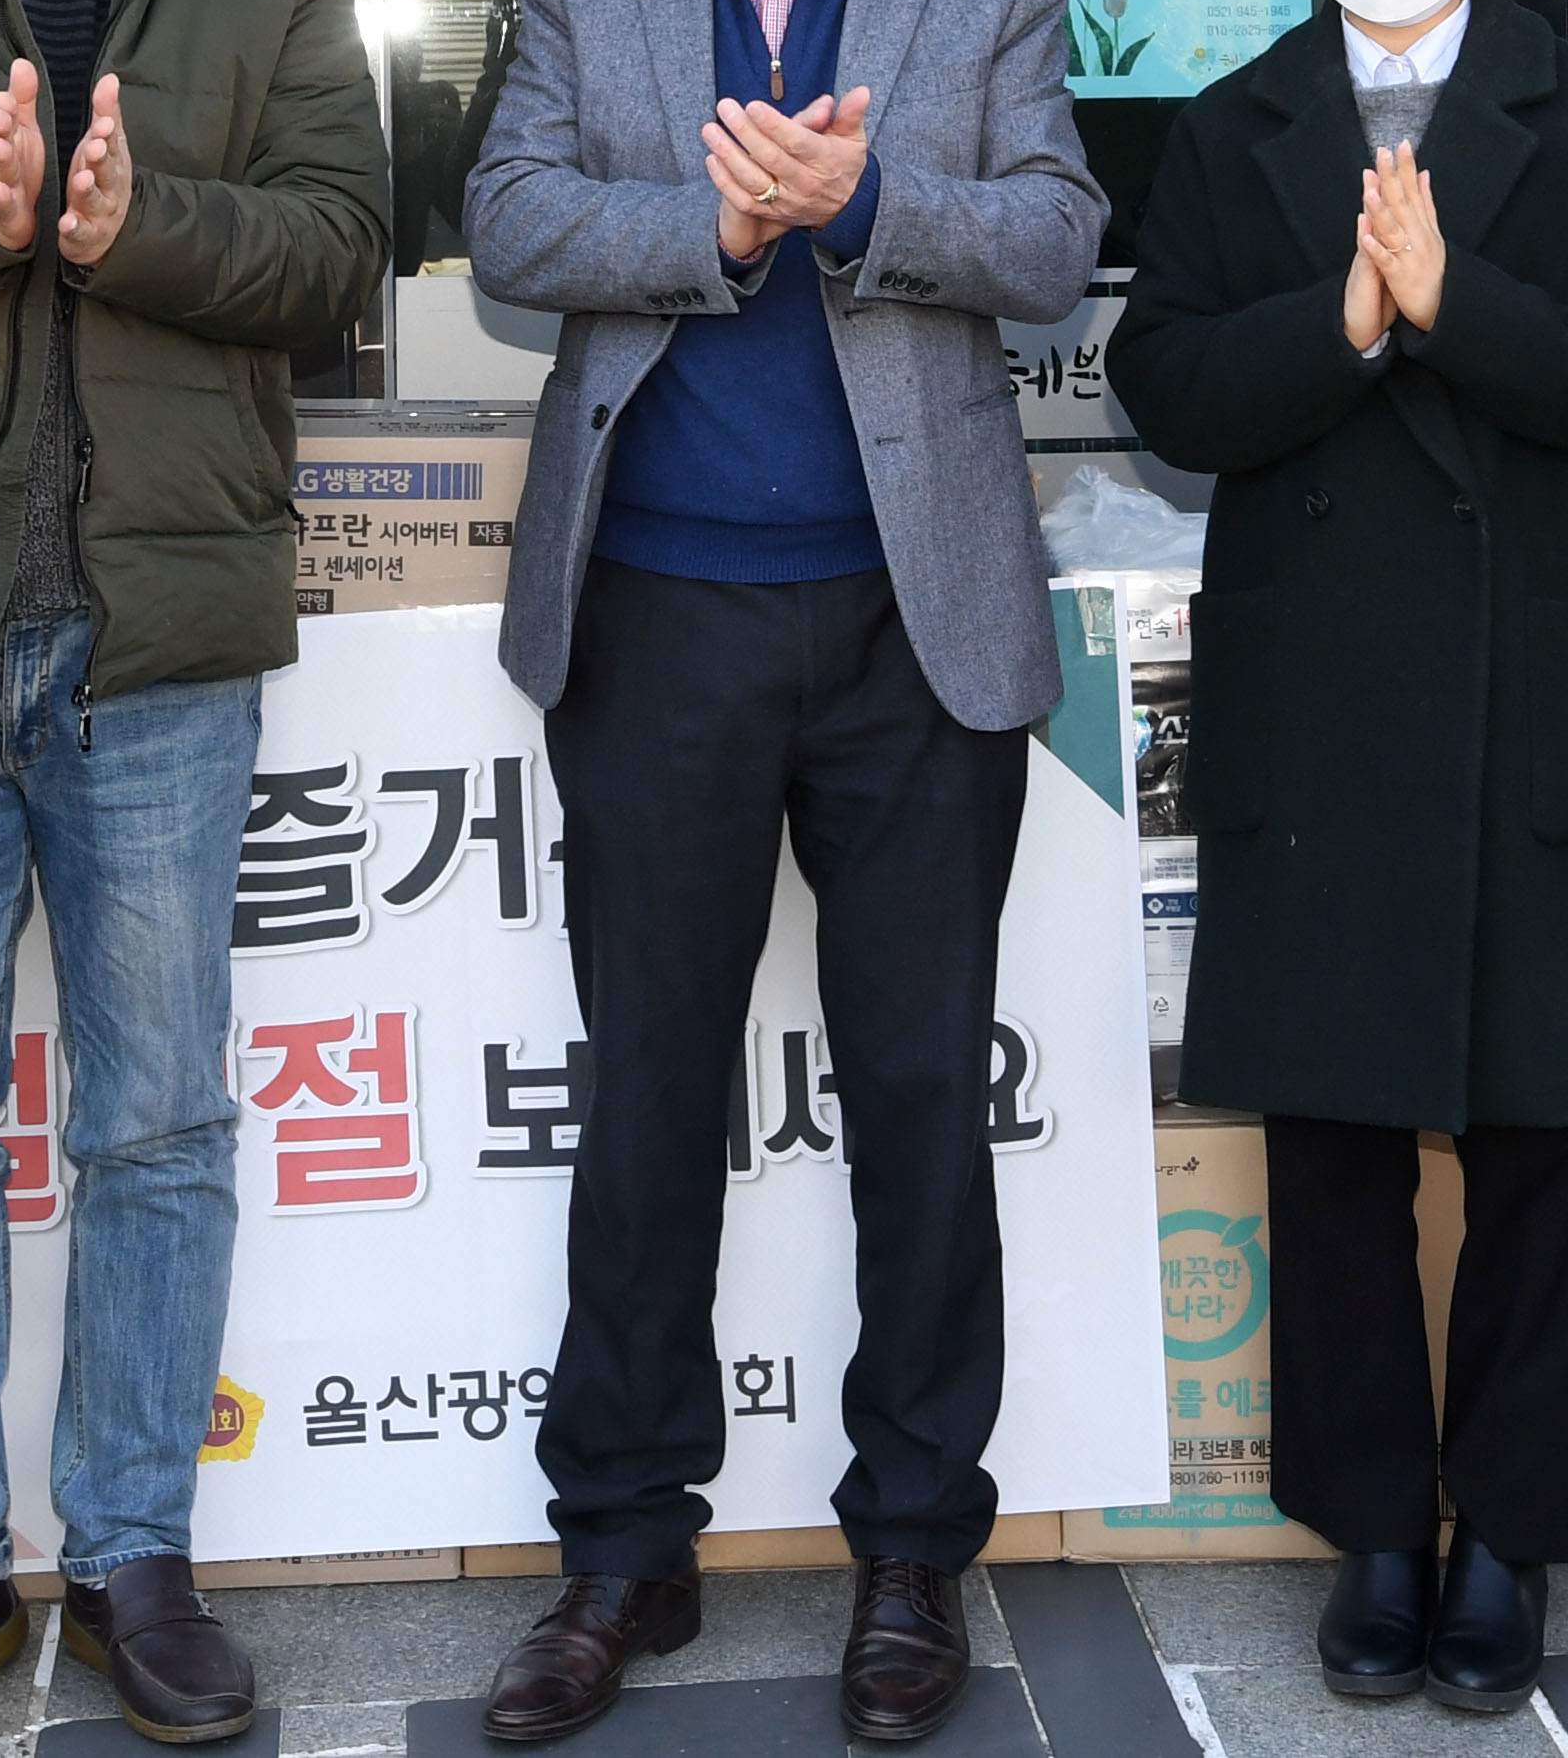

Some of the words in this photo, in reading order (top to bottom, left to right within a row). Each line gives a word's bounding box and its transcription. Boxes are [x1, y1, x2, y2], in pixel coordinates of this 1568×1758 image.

[293, 468, 319, 492] G
[321, 467, 413, 493] 생활건강
[379, 521, 459, 547] 시어버터
[473, 524, 507, 544] 자동
[324, 555, 404, 581] 센세이션
[1173, 607, 1191, 636] 1
[1154, 714, 1191, 745] 소
[232, 755, 567, 946] 즐거
[225, 1010, 419, 1208] 절
[1165, 1294, 1229, 1324] 나라
[1199, 1440, 1246, 1461] 점보롤
